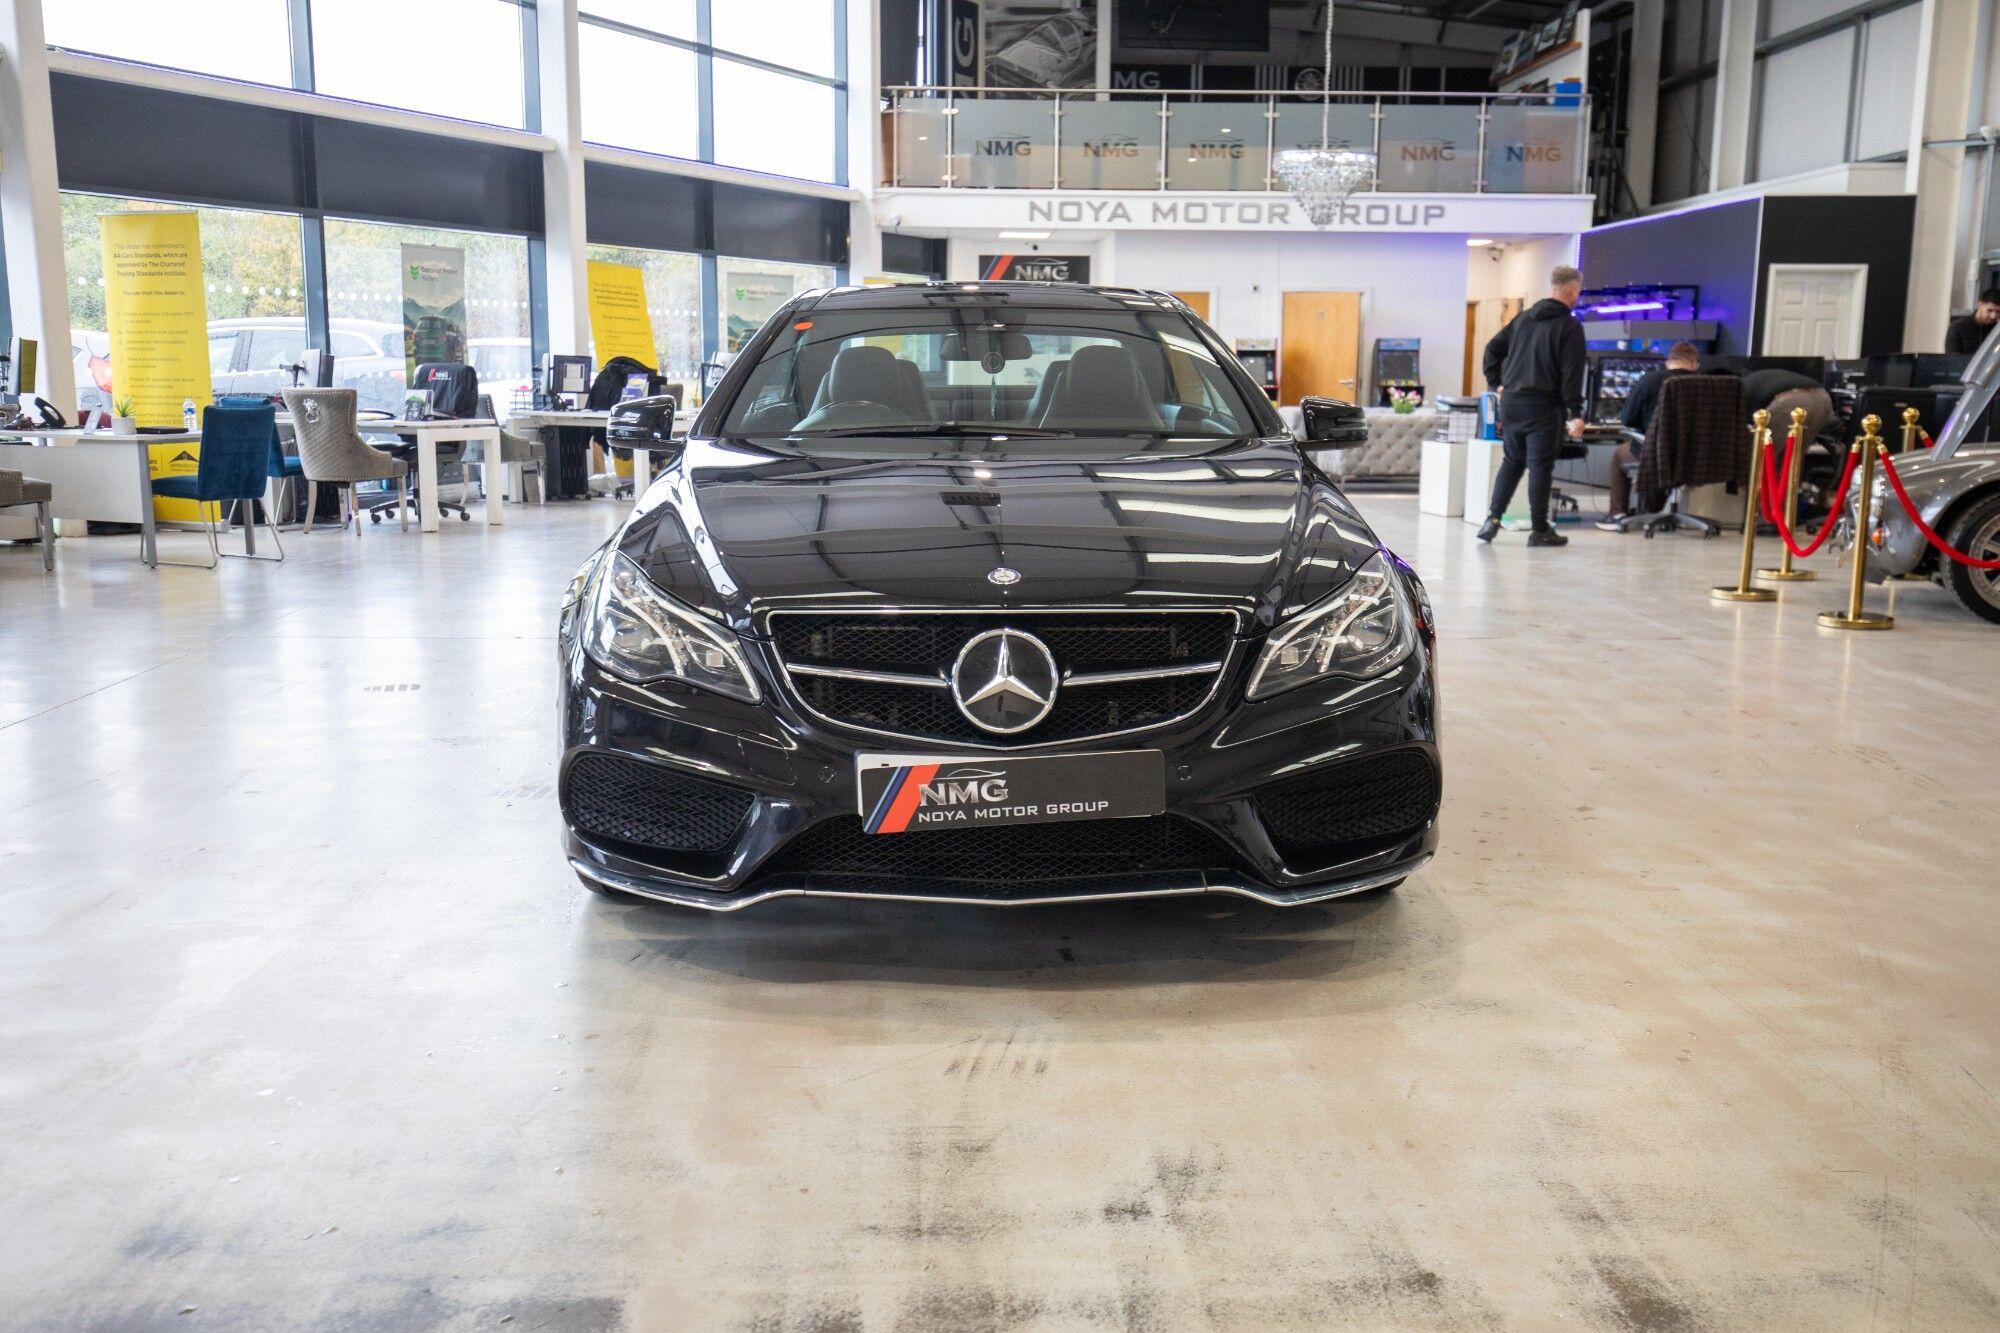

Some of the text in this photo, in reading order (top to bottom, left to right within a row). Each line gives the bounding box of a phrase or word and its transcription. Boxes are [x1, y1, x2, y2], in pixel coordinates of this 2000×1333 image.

[976, 140, 1032, 156] NMG
[1083, 141, 1139, 157] NMG
[1190, 143, 1245, 159] NMG
[1401, 146, 1456, 161] NMG
[1506, 145, 1562, 161] NMG
[1028, 200, 1447, 226] NOYA MOTOR ROUP
[1015, 265, 1070, 281] NMG
[918, 778, 1009, 807] NMG
[918, 800, 1109, 823] NOYA MOTOR GROUP
